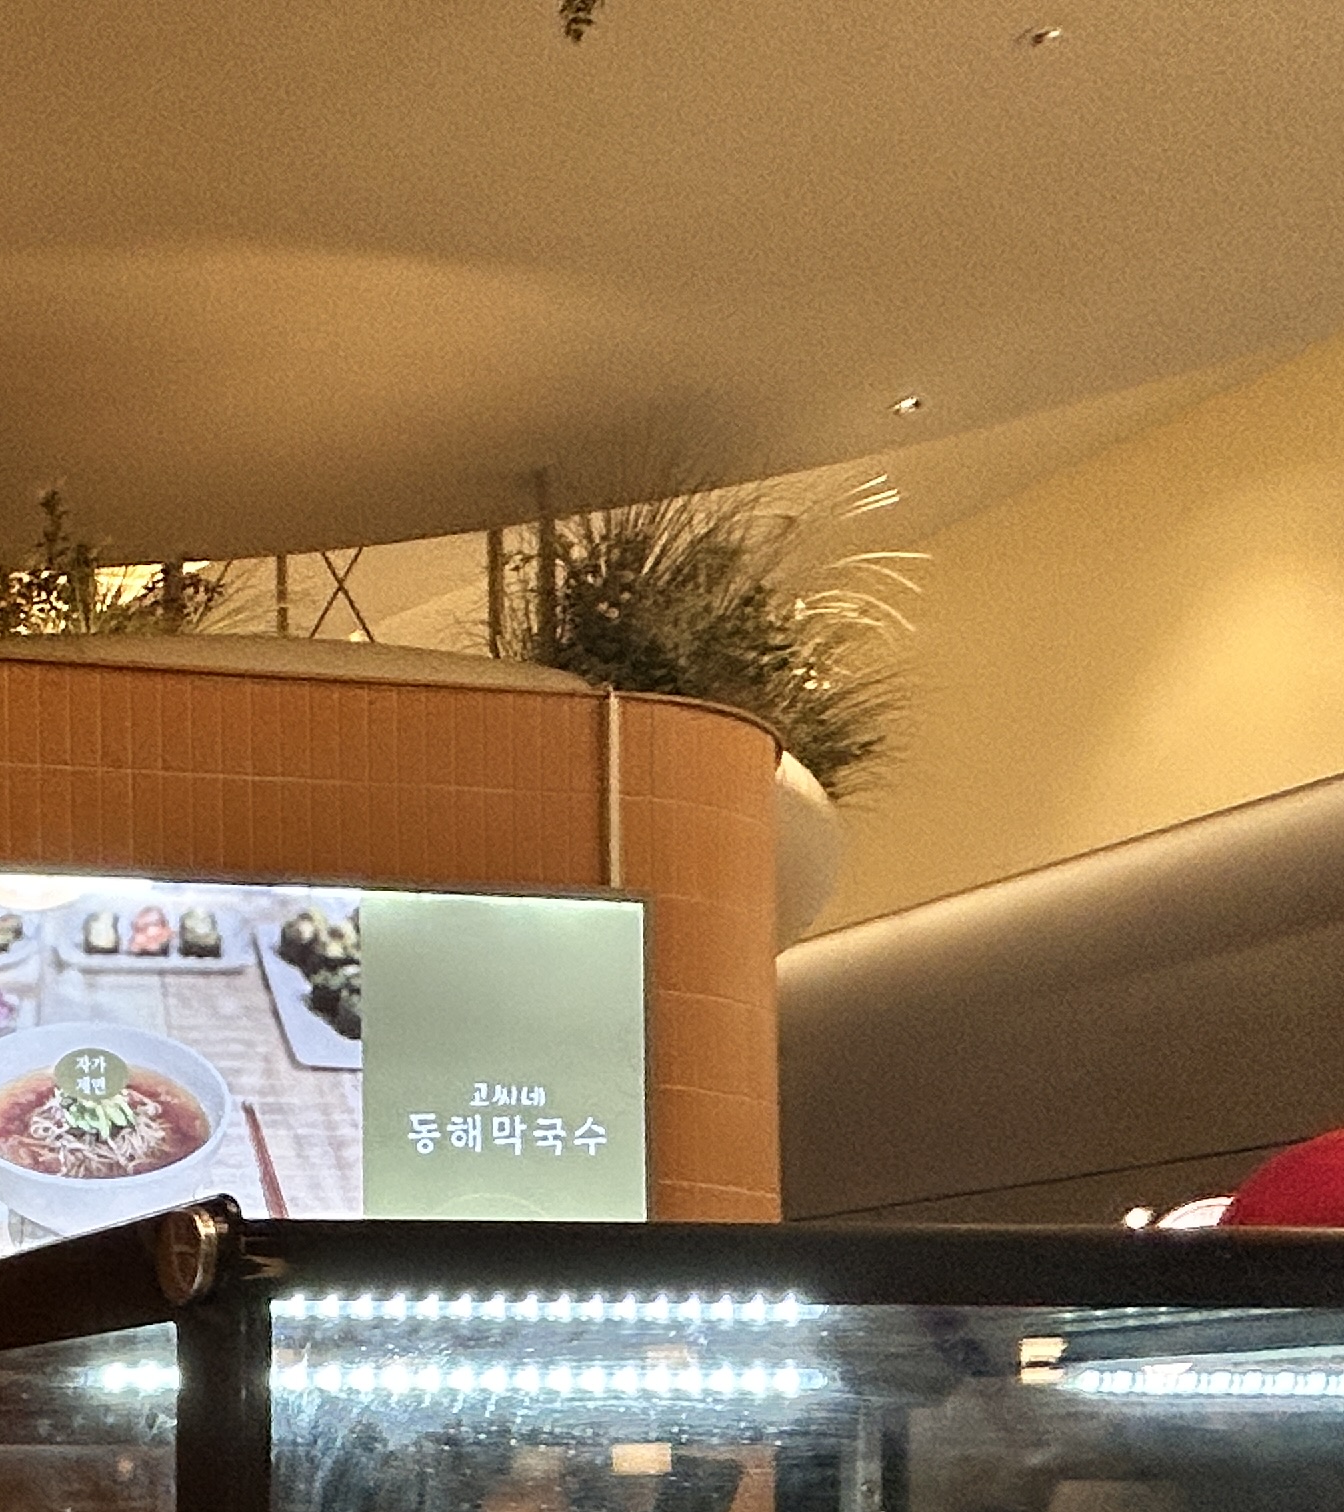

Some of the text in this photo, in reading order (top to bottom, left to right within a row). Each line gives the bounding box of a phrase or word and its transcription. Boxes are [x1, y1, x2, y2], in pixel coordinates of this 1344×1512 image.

[75, 1054, 107, 1074] 자가
[469, 1082, 547, 1107] 고씨네
[407, 1112, 608, 1156] 동해막국수
